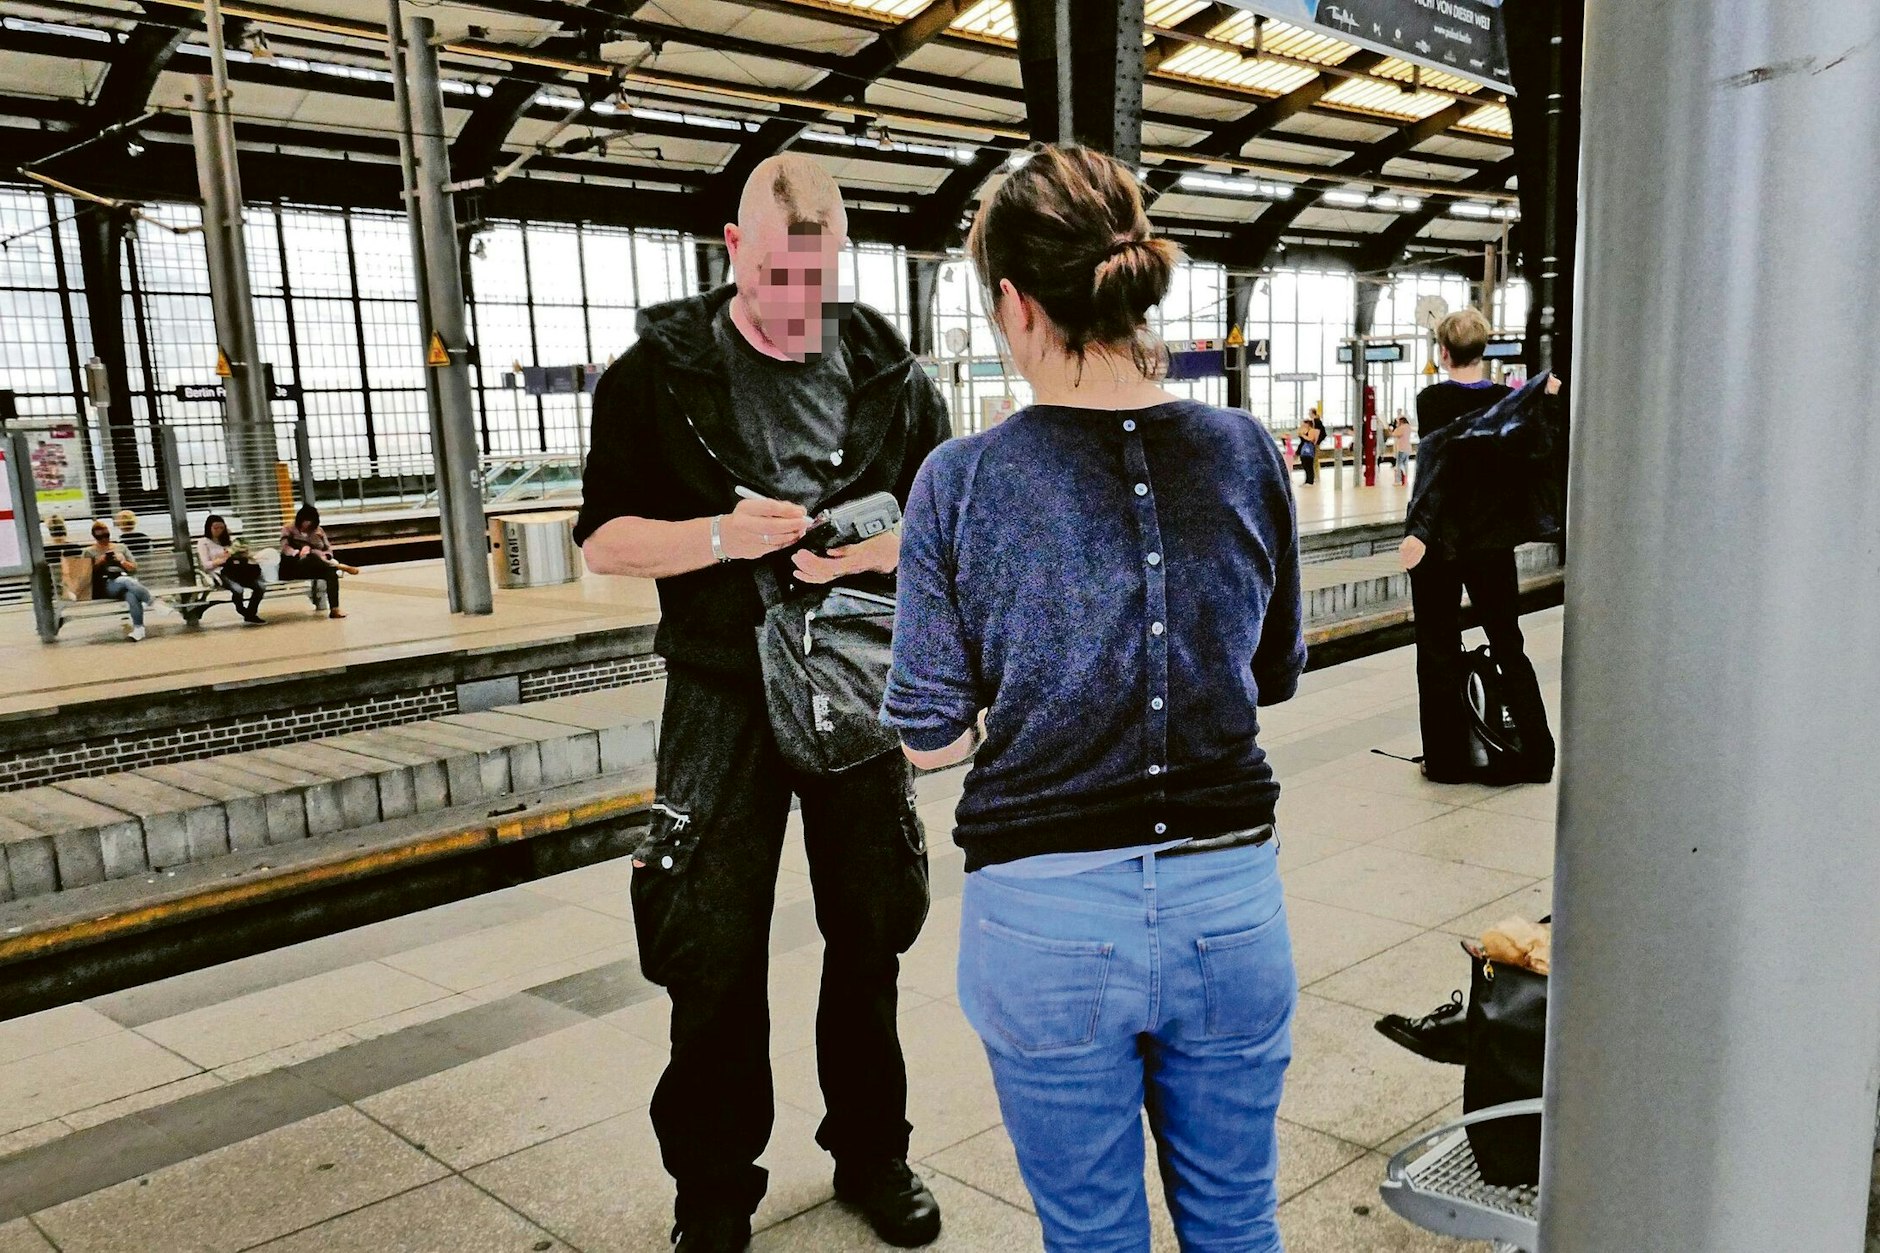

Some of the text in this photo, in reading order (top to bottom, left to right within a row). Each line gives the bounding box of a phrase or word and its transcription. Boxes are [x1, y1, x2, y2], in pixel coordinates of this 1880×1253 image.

[1436, 0, 1452, 16] VON
[1453, 4, 1474, 24] DIESER
[1475, 13, 1490, 30] WELT
[1255, 339, 1268, 360] 4
[185, 387, 215, 398] Berlin
[508, 538, 520, 575] Abfall
